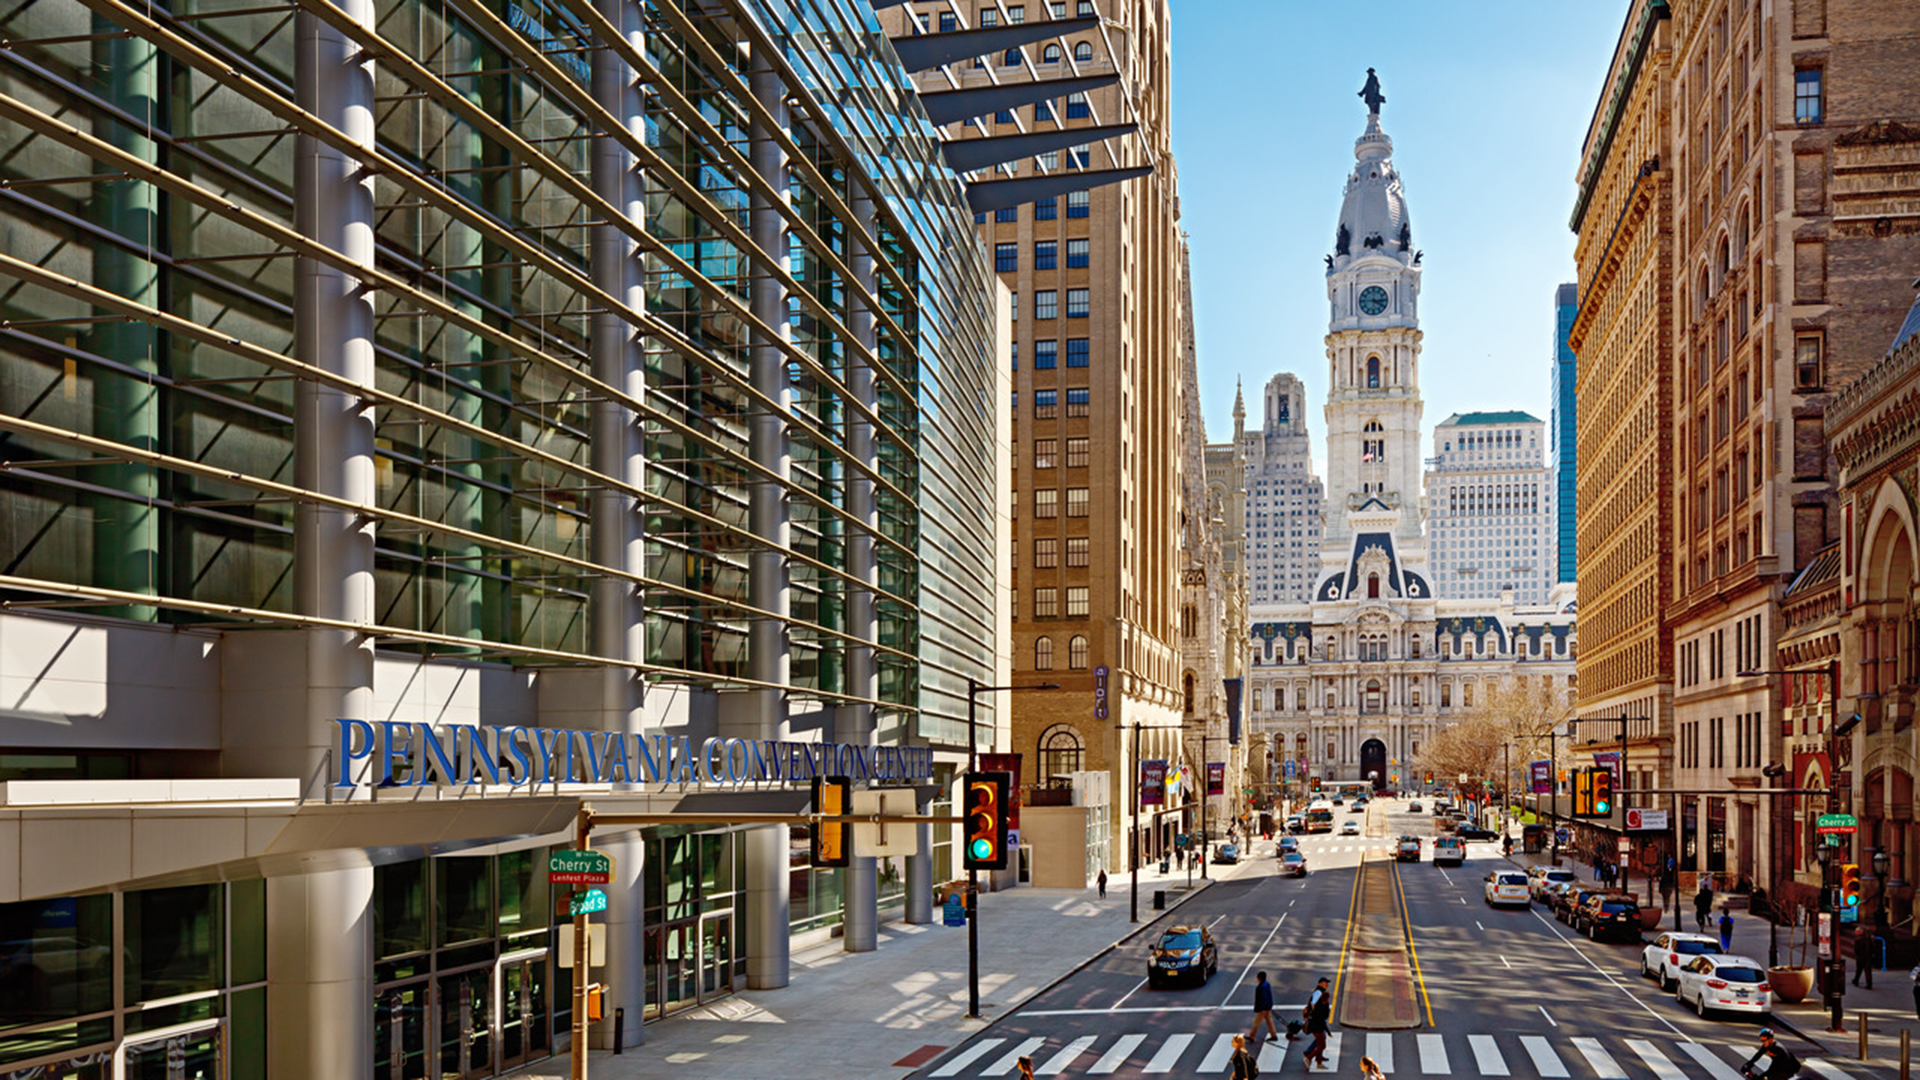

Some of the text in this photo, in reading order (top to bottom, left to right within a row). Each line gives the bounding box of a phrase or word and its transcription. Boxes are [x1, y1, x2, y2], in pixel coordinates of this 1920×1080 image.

[332, 718, 934, 788] PENNSYLVANIA CONVENTION CENTER
[550, 858, 607, 873] Cherry St
[552, 874, 605, 882] Lenfest Plaza
[597, 897, 606, 908] St
